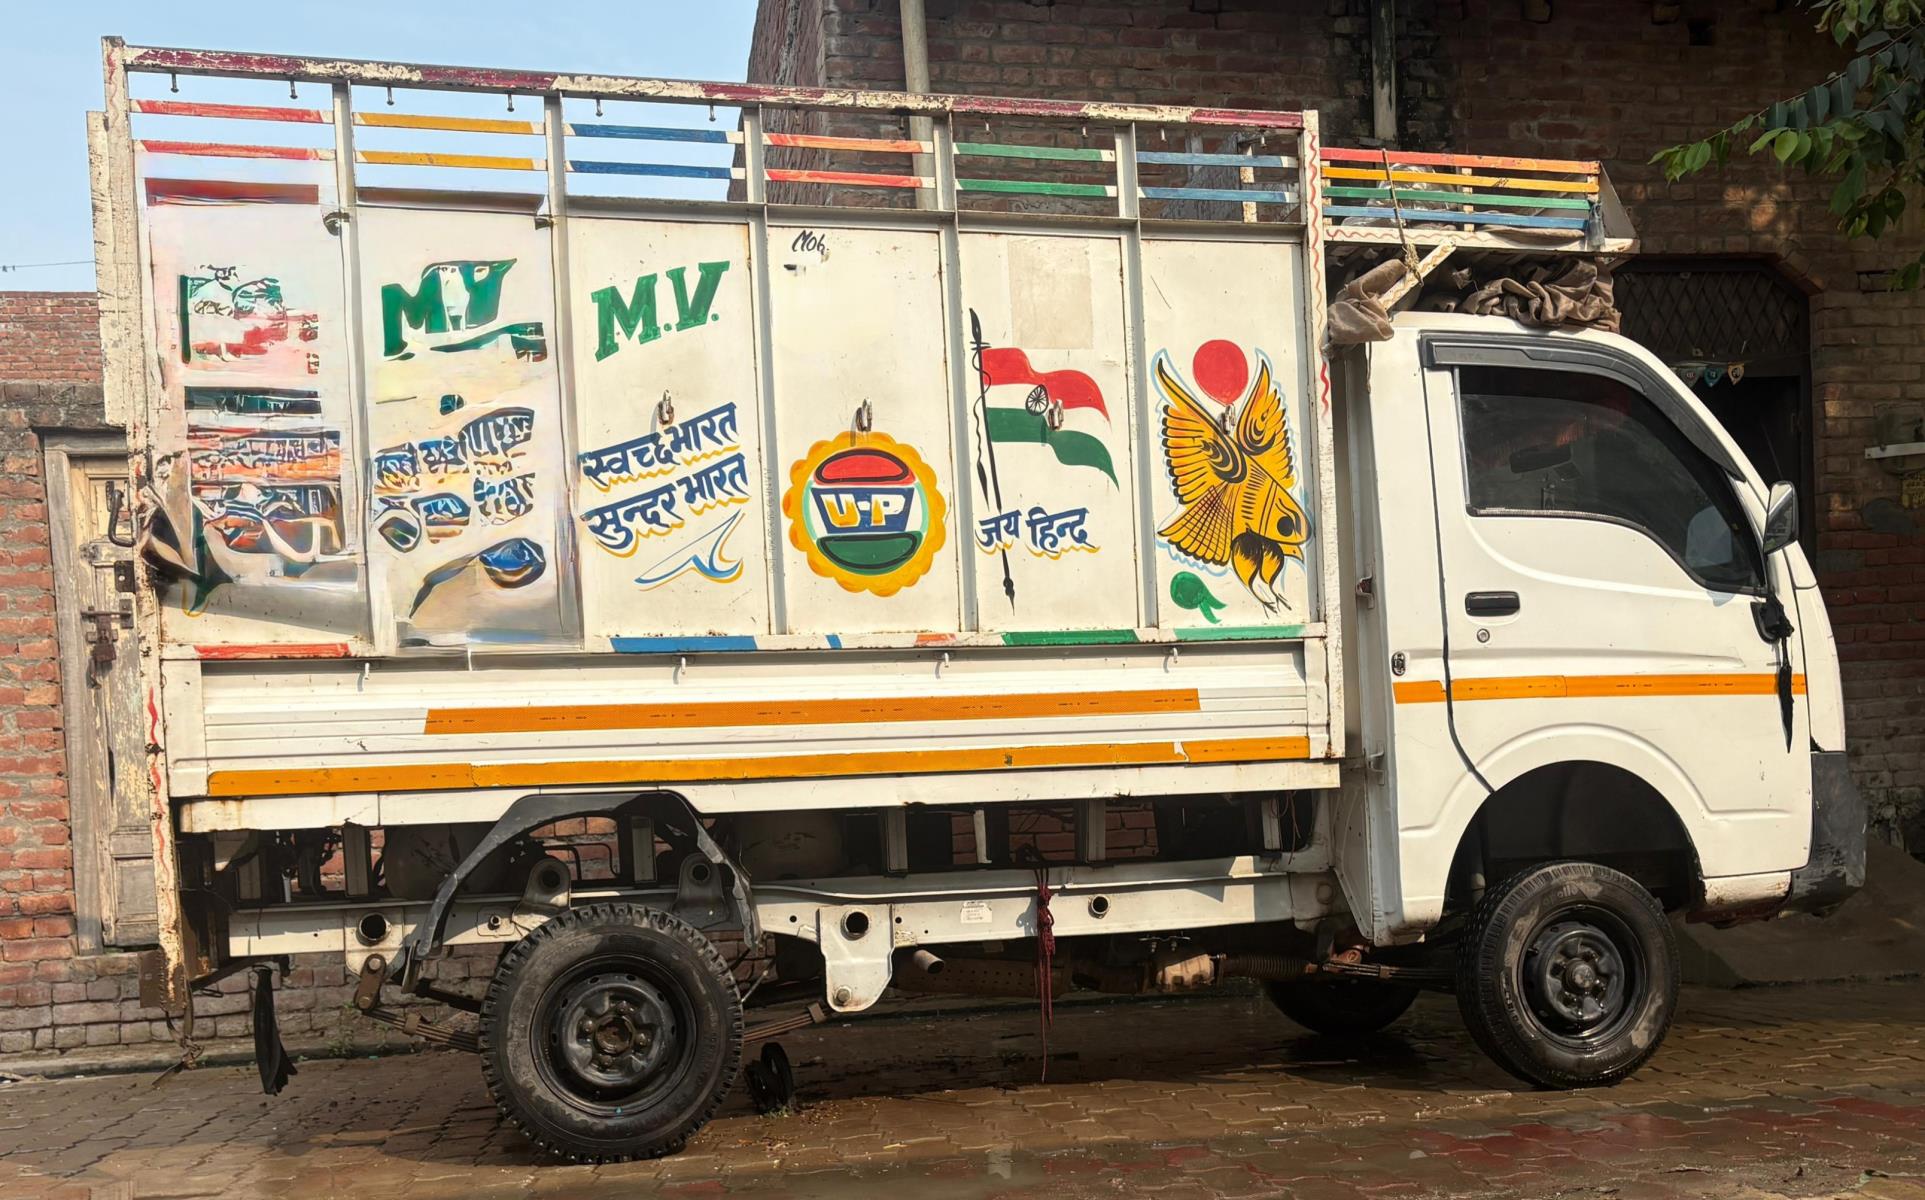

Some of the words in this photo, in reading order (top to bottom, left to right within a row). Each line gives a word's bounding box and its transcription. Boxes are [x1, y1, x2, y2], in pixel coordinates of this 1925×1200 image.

[590, 260, 730, 362] M.V.
[664, 401, 739, 453] भारत
[580, 482, 685, 550] सुन्दर
[676, 452, 751, 504] भारत
[975, 509, 1022, 547] जय
[1025, 506, 1096, 554] हिन्द
